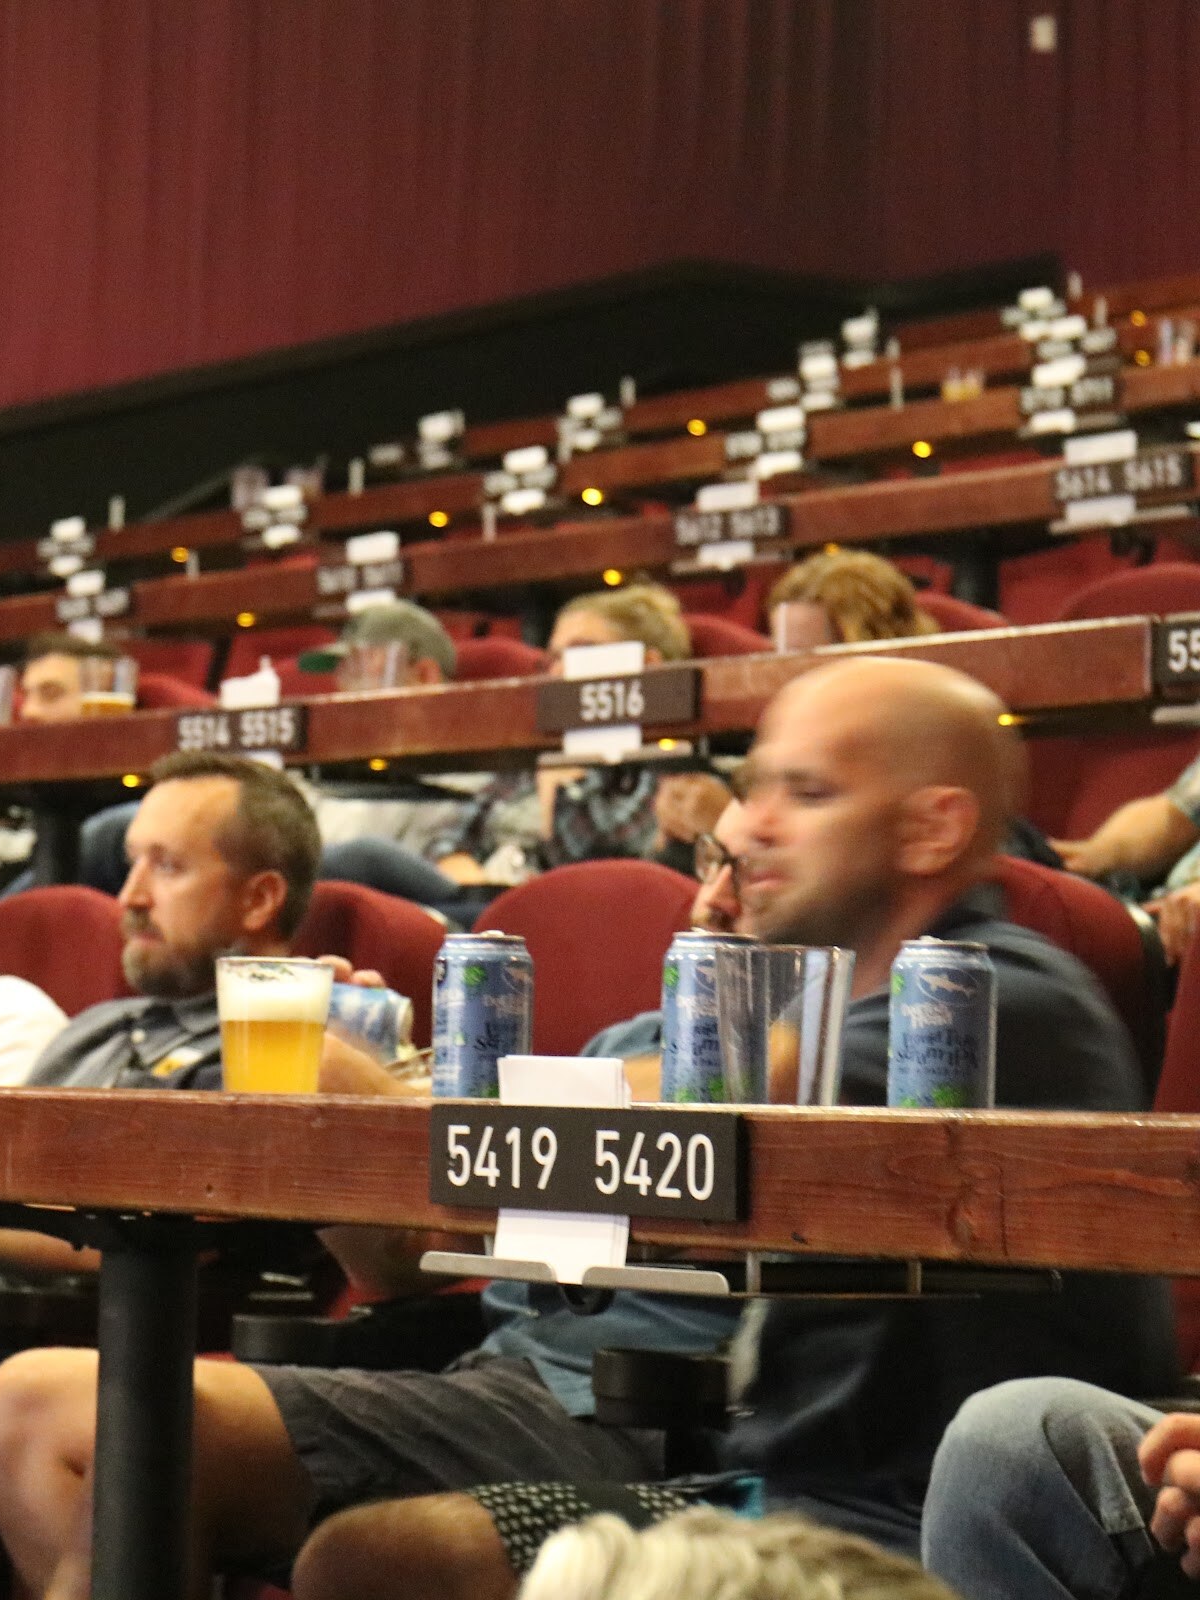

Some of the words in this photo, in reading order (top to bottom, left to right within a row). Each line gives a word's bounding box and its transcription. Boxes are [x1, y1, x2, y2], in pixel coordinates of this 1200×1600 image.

[581, 681, 644, 720] 5516
[179, 714, 230, 750] 5514
[240, 708, 294, 746] 5515
[447, 1124, 558, 1190] 5419
[594, 1130, 715, 1201] 5420
